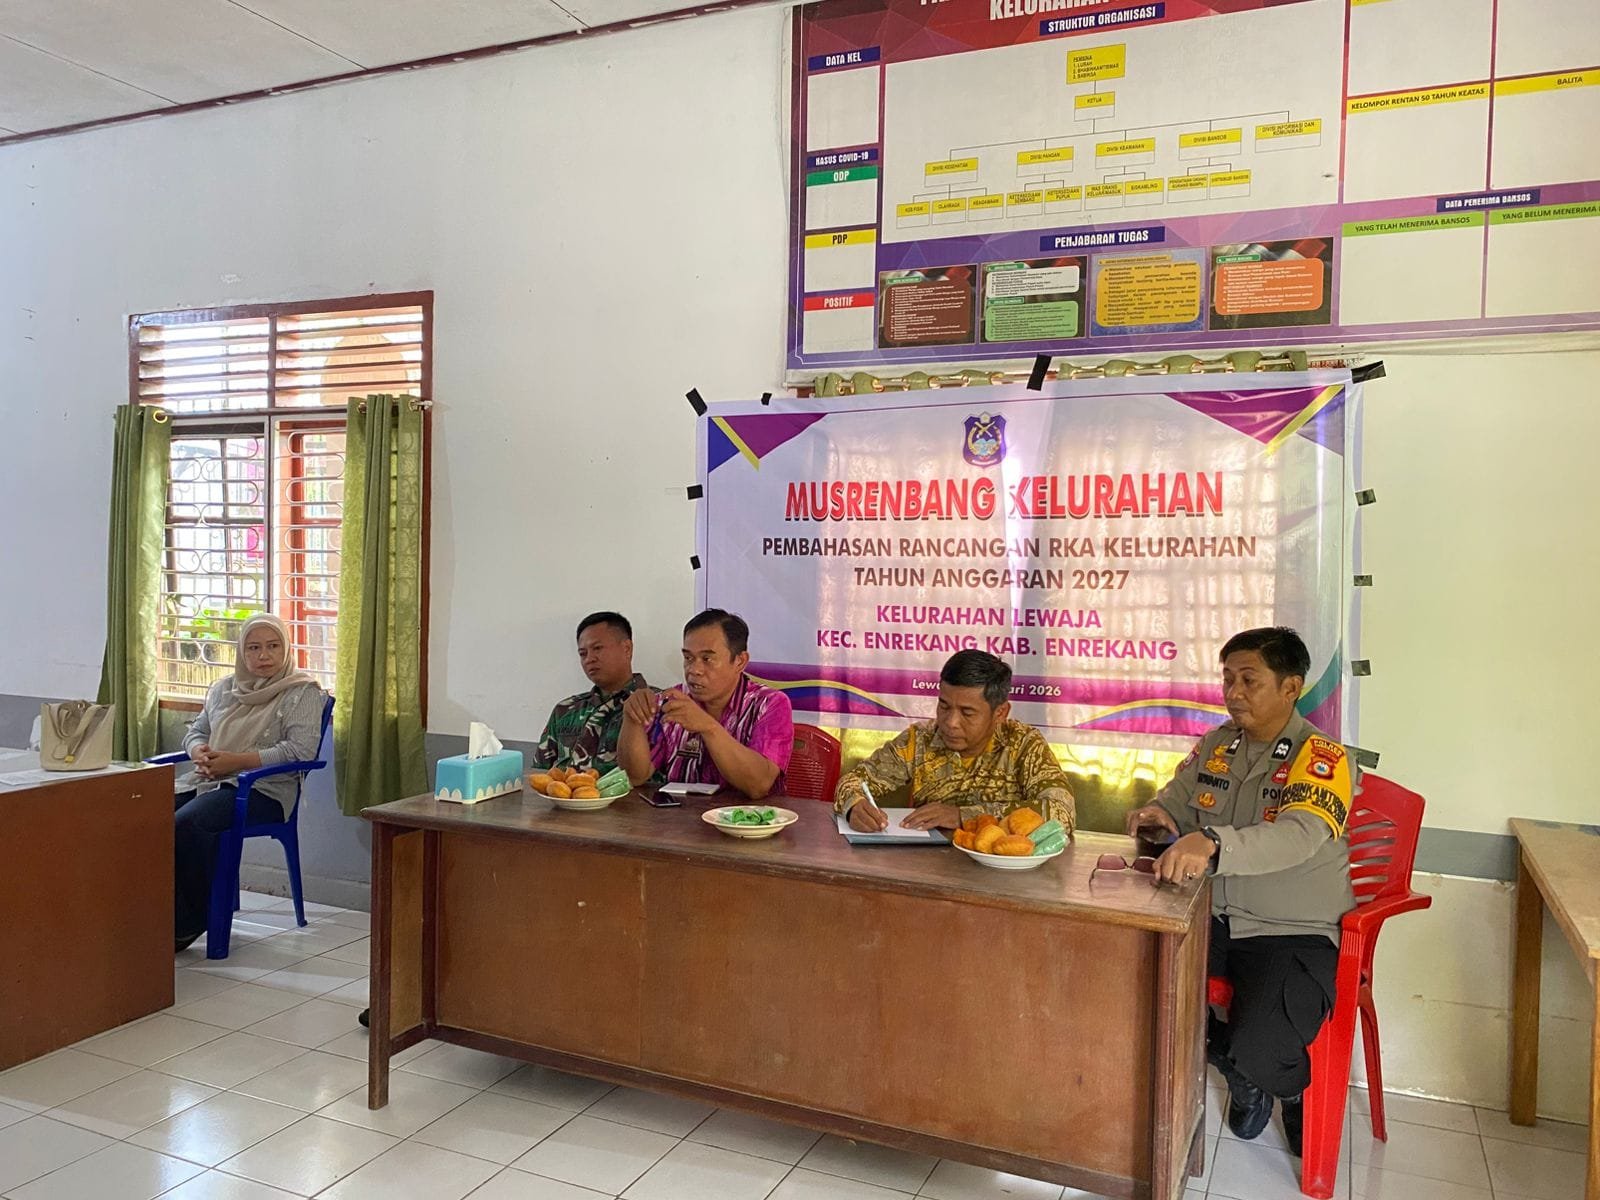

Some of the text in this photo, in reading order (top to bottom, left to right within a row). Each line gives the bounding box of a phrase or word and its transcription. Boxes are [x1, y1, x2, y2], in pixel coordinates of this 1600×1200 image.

[1048, 6, 1156, 33] STRUKTUR ORGANISASI
[826, 52, 862, 66] DATA KEL
[1557, 76, 1583, 85] BALITA
[1351, 99, 1390, 109] KELOMPOK
[1391, 96, 1420, 105] RENTAN
[1432, 91, 1457, 100] TAHUN
[1458, 87, 1485, 97] KEATAS
[816, 152, 869, 166] KASUS COVID-19
[833, 171, 849, 181] ODP
[1445, 193, 1531, 208] DATA PENERIMA BANSOS
[1502, 211, 1523, 220] YANG
[1524, 209, 1551, 218] BELUM
[1553, 206, 1597, 215] MENERIMA
[1355, 216, 1470, 232] YANG TELAH MENERIMA BANSOS
[832, 233, 848, 245] PDP
[1054, 230, 1149, 248] PENJABARAN TUGAS
[824, 296, 854, 308] POSITIF
[785, 471, 1223, 521] MUSRENBANG KELURAHAN
[762, 536, 1256, 558] PEMBAHASAN RANCANGAN RKA KELURAHAN
[855, 567, 1130, 590] TAHUN ANGGARAN 2027
[876, 605, 1101, 629] KELURAHAN LEWAJA
[816, 630, 1178, 661] KEC. ENREKANG KAB. ENREKANG
[1029, 685, 1062, 696] 2026
